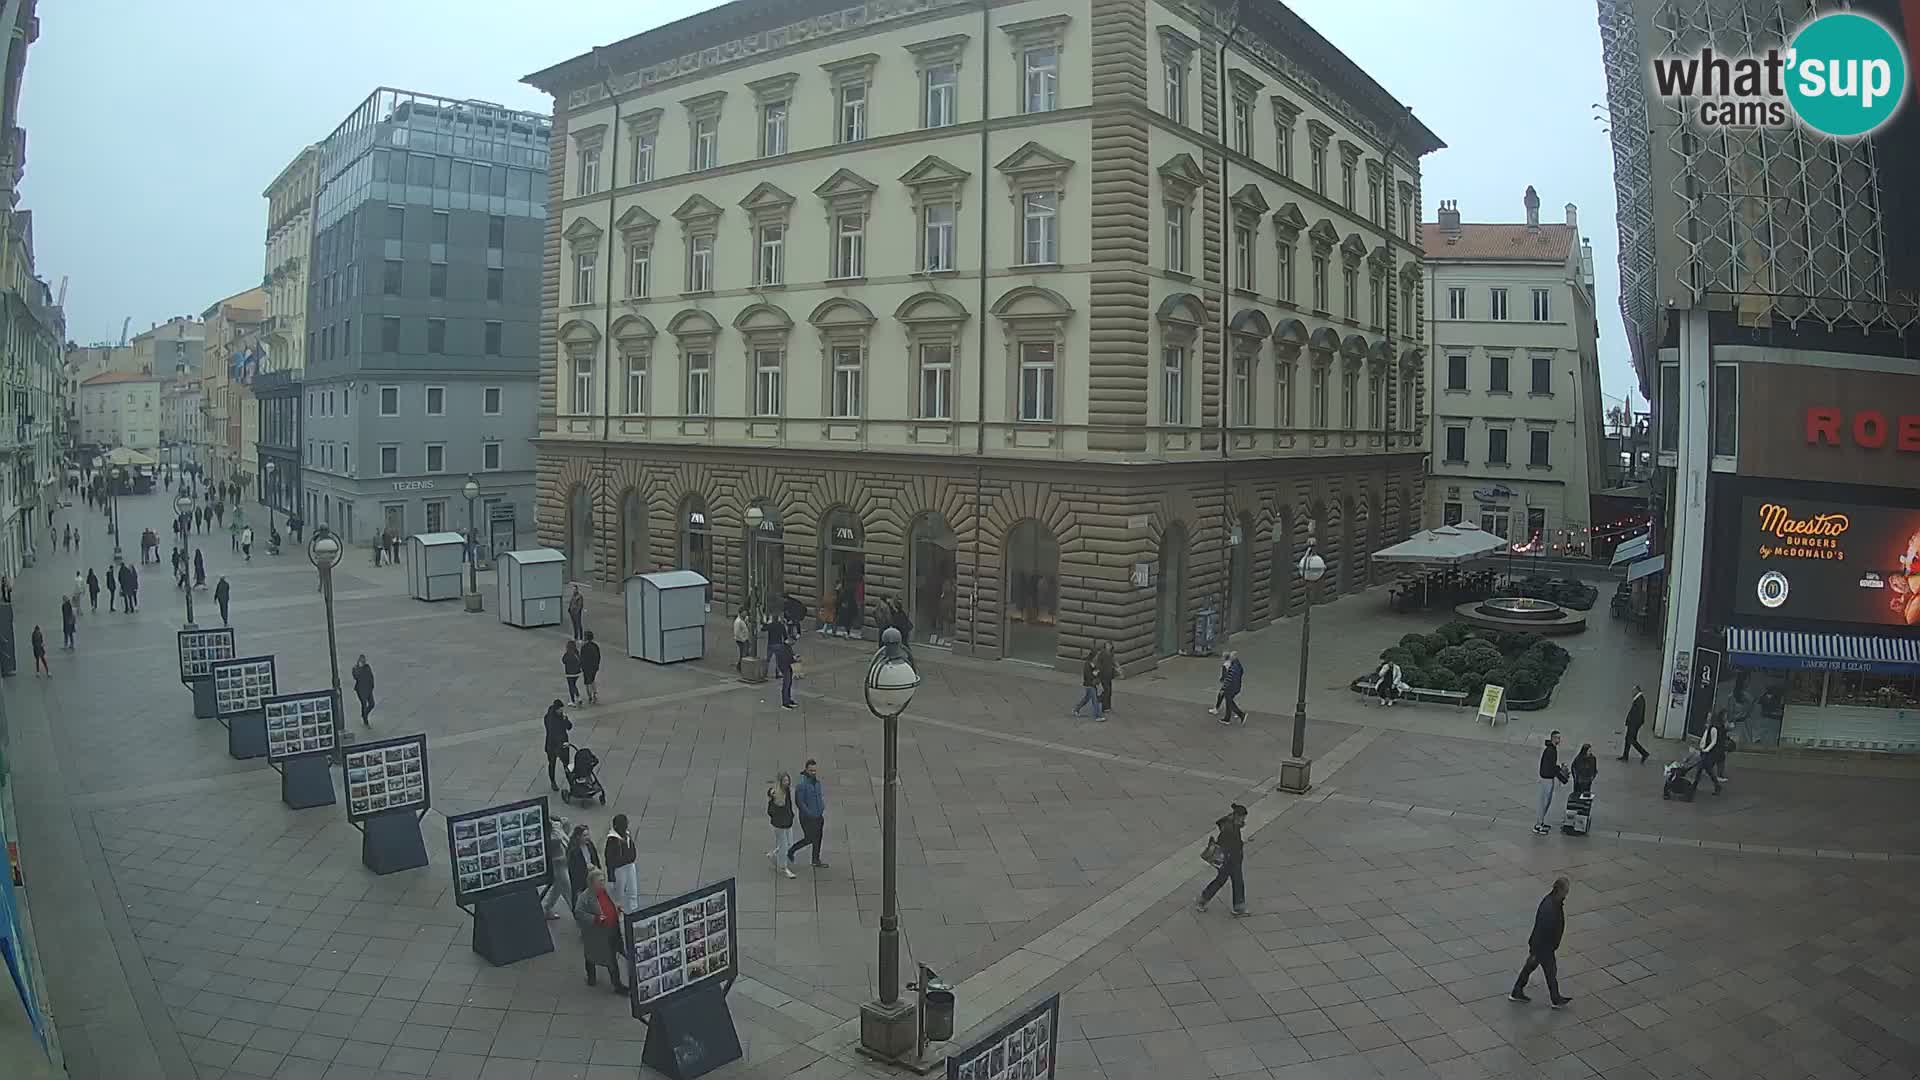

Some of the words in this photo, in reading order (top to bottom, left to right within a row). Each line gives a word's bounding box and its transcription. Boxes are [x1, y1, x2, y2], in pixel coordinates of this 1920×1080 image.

[392, 480, 434, 490] TEZENIS
[1760, 503, 1849, 537] Maestro
[1786, 536, 1837, 548] BURGERS
